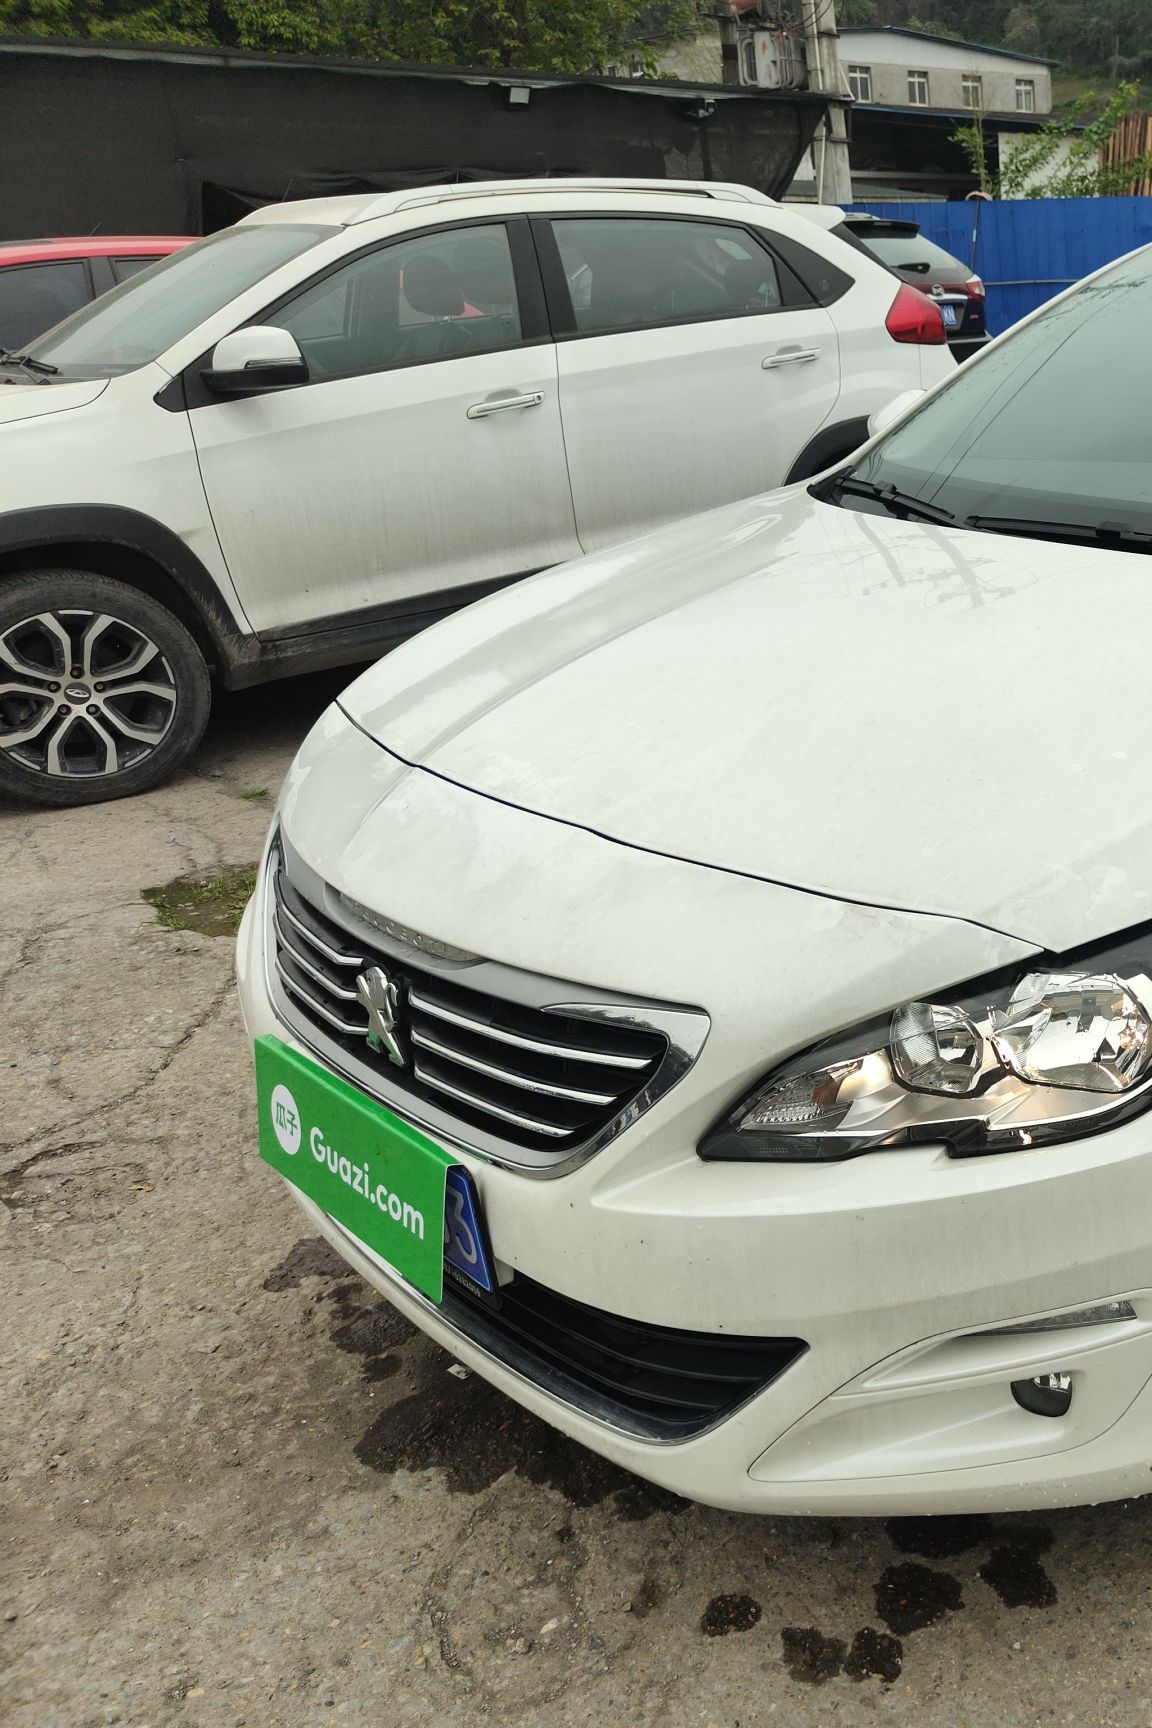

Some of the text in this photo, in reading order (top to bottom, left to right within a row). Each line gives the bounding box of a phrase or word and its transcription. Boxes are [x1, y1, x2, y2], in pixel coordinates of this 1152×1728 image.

[275, 1101, 299, 1137] 瓜子
[309, 1126, 425, 1241] Guazi.com
[445, 1185, 478, 1265] 3
